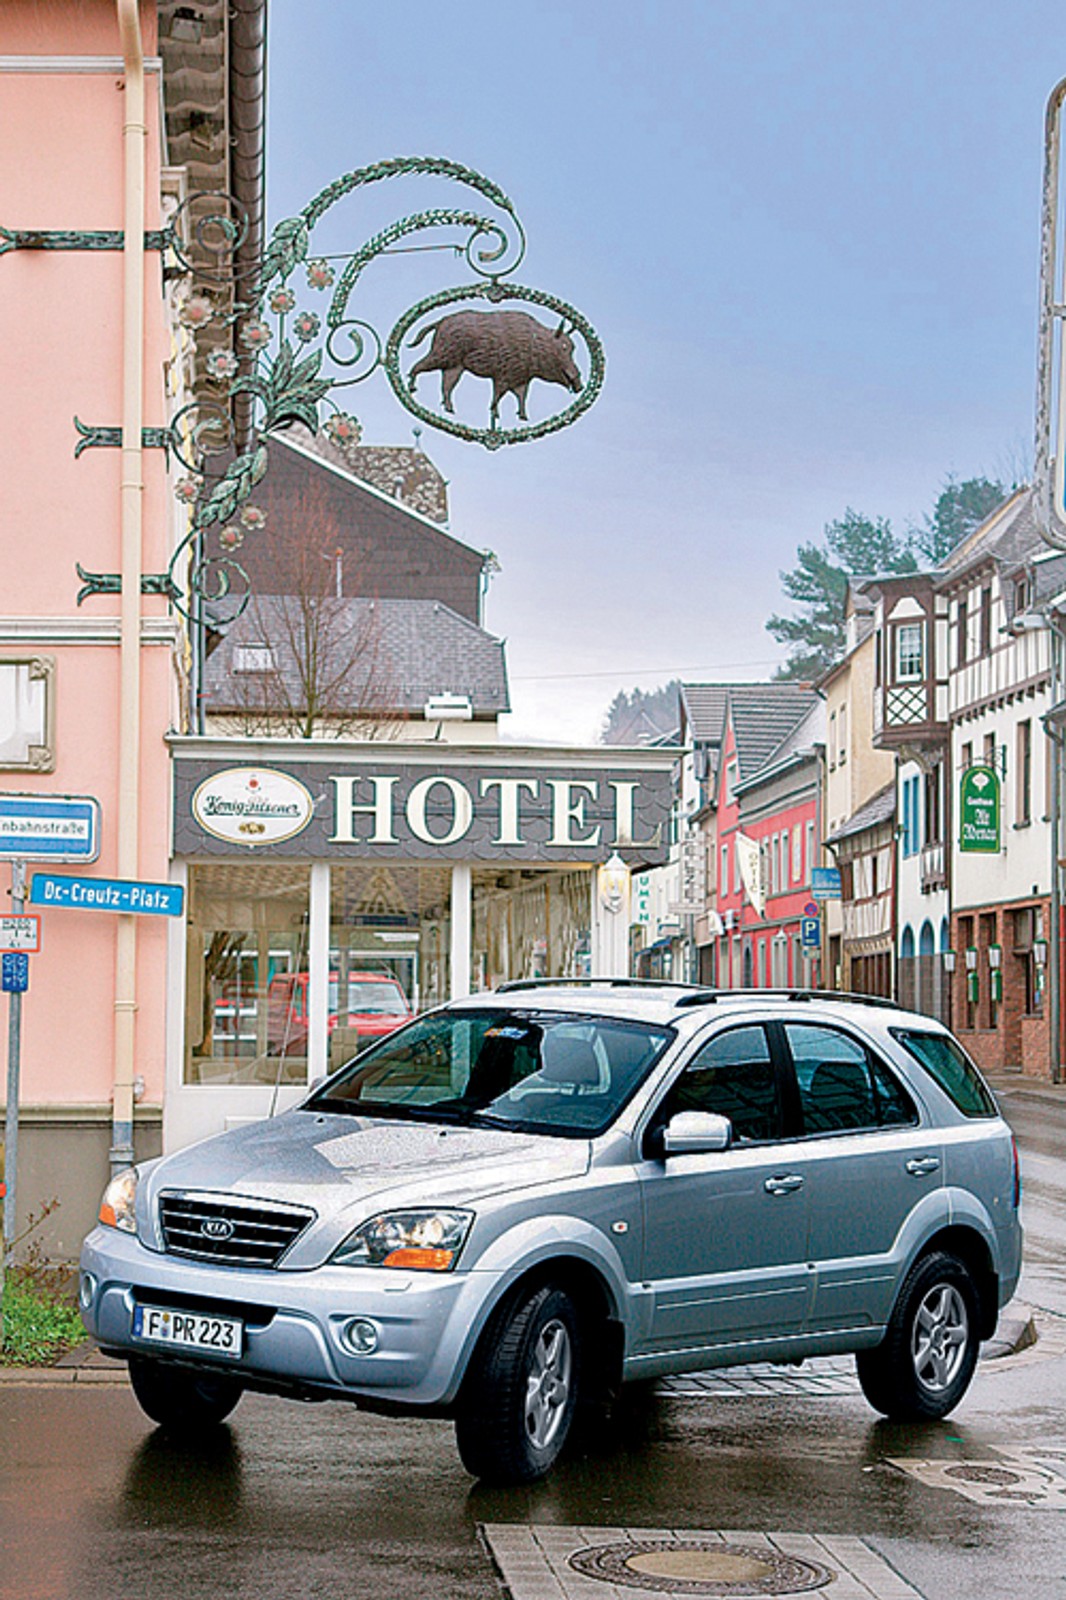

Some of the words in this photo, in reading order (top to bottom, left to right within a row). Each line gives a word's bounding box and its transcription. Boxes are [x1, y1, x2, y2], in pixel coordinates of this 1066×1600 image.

[327, 775, 662, 850] HOTEL
[205, 1222, 229, 1236] KIA
[148, 1311, 162, 1337] F
[172, 1315, 196, 1343] PR
[199, 1320, 235, 1348] 223
